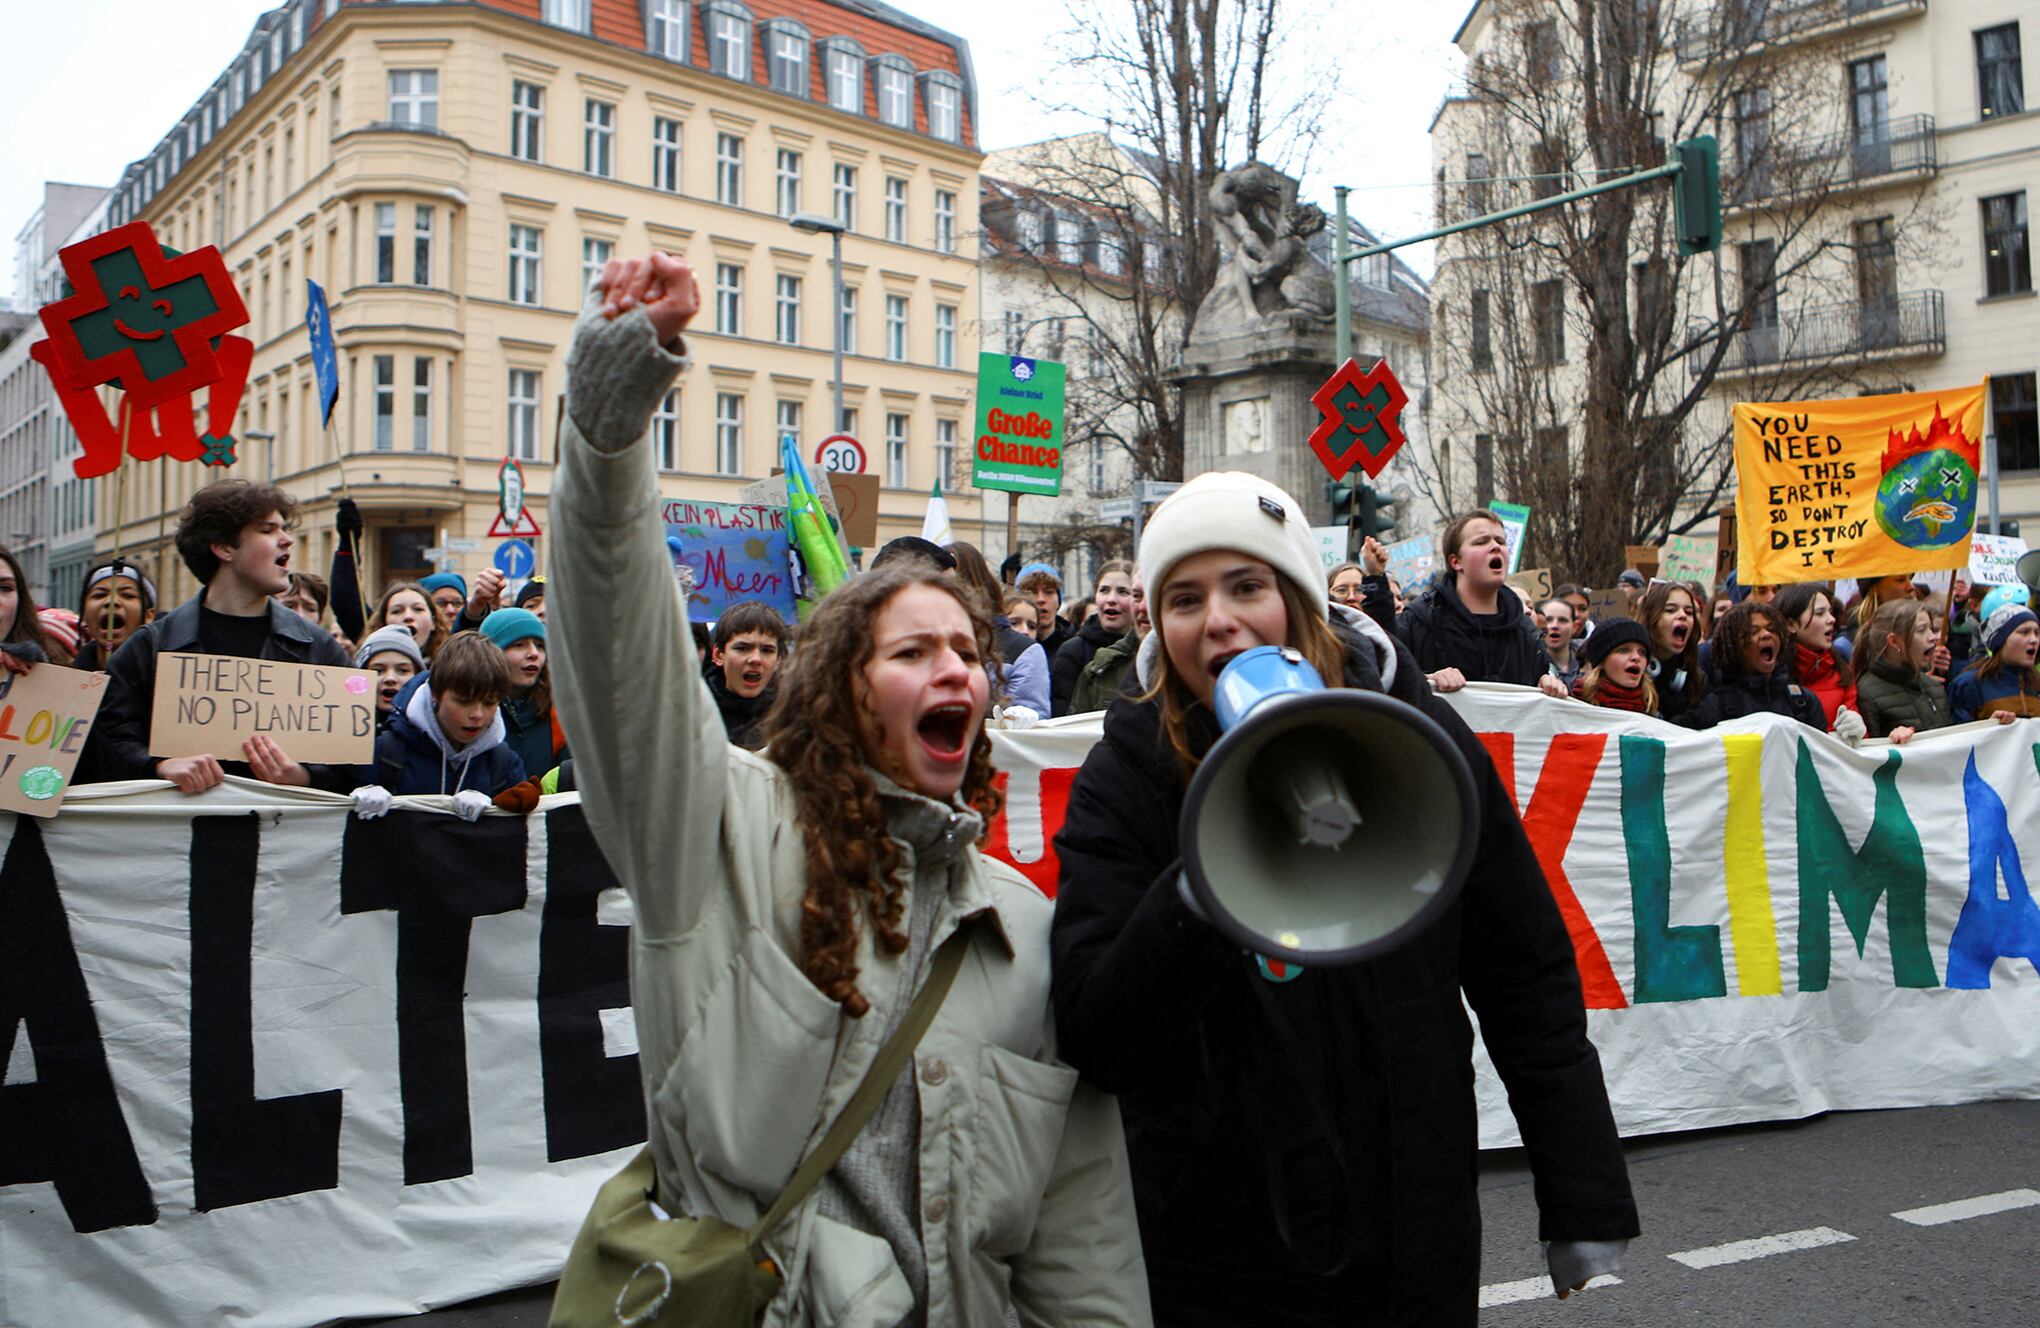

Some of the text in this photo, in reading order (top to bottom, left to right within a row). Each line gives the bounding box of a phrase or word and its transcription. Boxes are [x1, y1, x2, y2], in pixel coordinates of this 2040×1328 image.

[988, 407, 1053, 439] Große
[1751, 413, 1809, 436] YOU
[826, 449, 856, 471] 30
[977, 435, 1060, 469] Chance
[1763, 435, 1842, 463] NEED
[1798, 461, 1856, 480] THIS
[1768, 481, 1851, 505] EARTH,
[703, 505, 786, 531] PLASTIK
[1769, 504, 1849, 523] SO DON'T
[1770, 519, 1868, 550] DESTROY
[694, 547, 783, 596] Meer
[1801, 550, 1835, 567] IT
[171, 655, 275, 696] THERE
[297, 669, 326, 700] IS
[0, 704, 88, 753] LOVE
[177, 694, 372, 738] NO PLANET B
